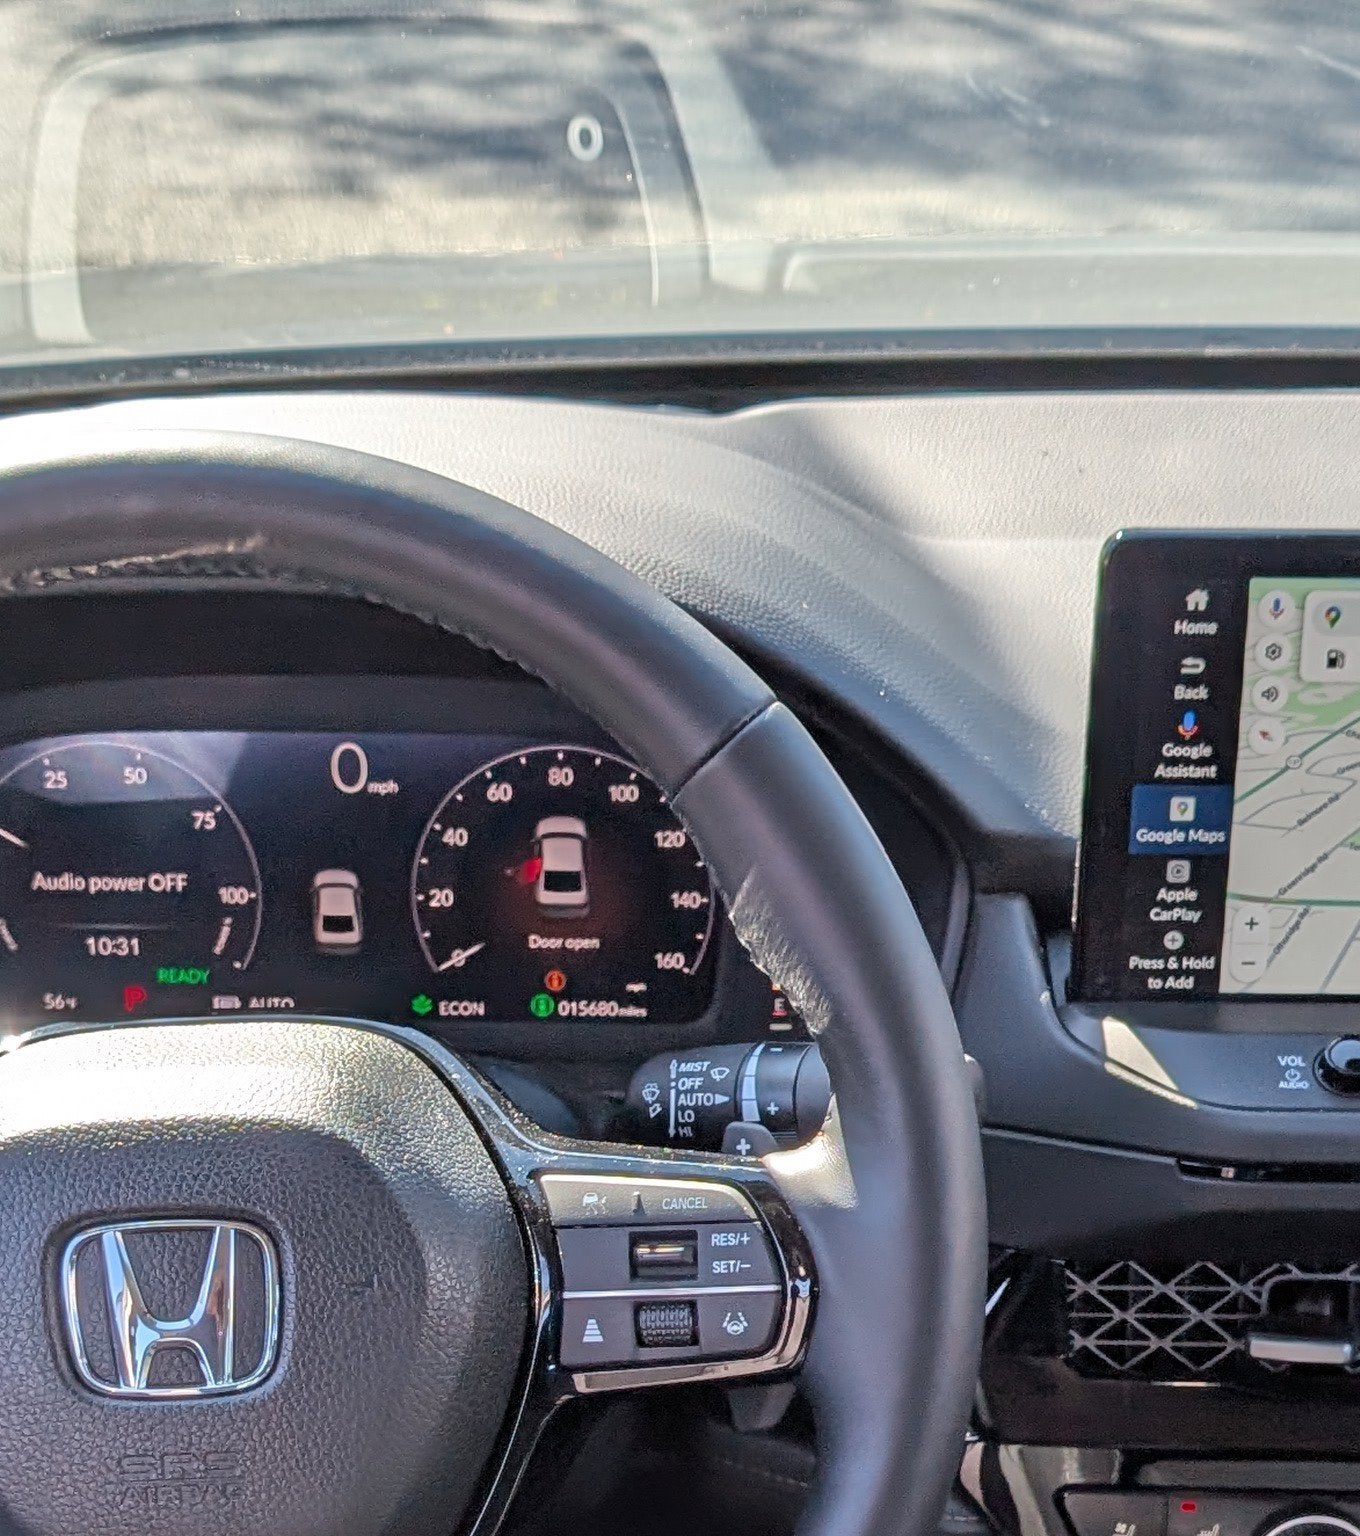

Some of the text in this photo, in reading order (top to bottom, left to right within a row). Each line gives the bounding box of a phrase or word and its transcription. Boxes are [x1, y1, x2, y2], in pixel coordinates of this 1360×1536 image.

[1174, 619, 1219, 635] Home
[1174, 684, 1210, 700] Back
[1161, 743, 1213, 760] Google
[124, 766, 148, 785] 50
[330, 741, 369, 794] 0
[547, 766, 575, 787] 80
[1154, 763, 1218, 780] Assistant
[42, 770, 68, 790] 25
[486, 782, 513, 803] 60
[608, 784, 641, 803] 100
[190, 810, 217, 830] 75
[441, 826, 469, 847] 40
[653, 830, 687, 848] 120
[1135, 829, 1226, 845] Google Maps
[31, 870, 189, 895] Audio power OFF
[217, 886, 250, 906] 100
[428, 887, 455, 908] 20
[670, 891, 702, 909] 140
[1156, 887, 1198, 904] Apple
[1149, 907, 1202, 924] CarPlay
[86, 936, 140, 957] 10:31
[527, 933, 601, 952] Door open
[653, 951, 686, 970] 160
[1128, 956, 1216, 970] Press & Hold
[157, 968, 211, 985] READY
[1147, 976, 1194, 988] to Add
[123, 984, 147, 1013] P
[439, 1000, 486, 1018] ECON
[557, 1000, 618, 1018] 015680
[678, 1061, 711, 1073] MIST
[1277, 1055, 1306, 1067] VOL
[677, 1077, 705, 1091] OFF
[1279, 1081, 1310, 1090] AUDIO
[677, 1092, 714, 1107] AUTO
[677, 1109, 695, 1123] LO
[677, 1125, 693, 1138] HI
[661, 1196, 708, 1211] CANCEL
[710, 1232, 751, 1248] RES/+
[120, 1451, 241, 1481] SRS
